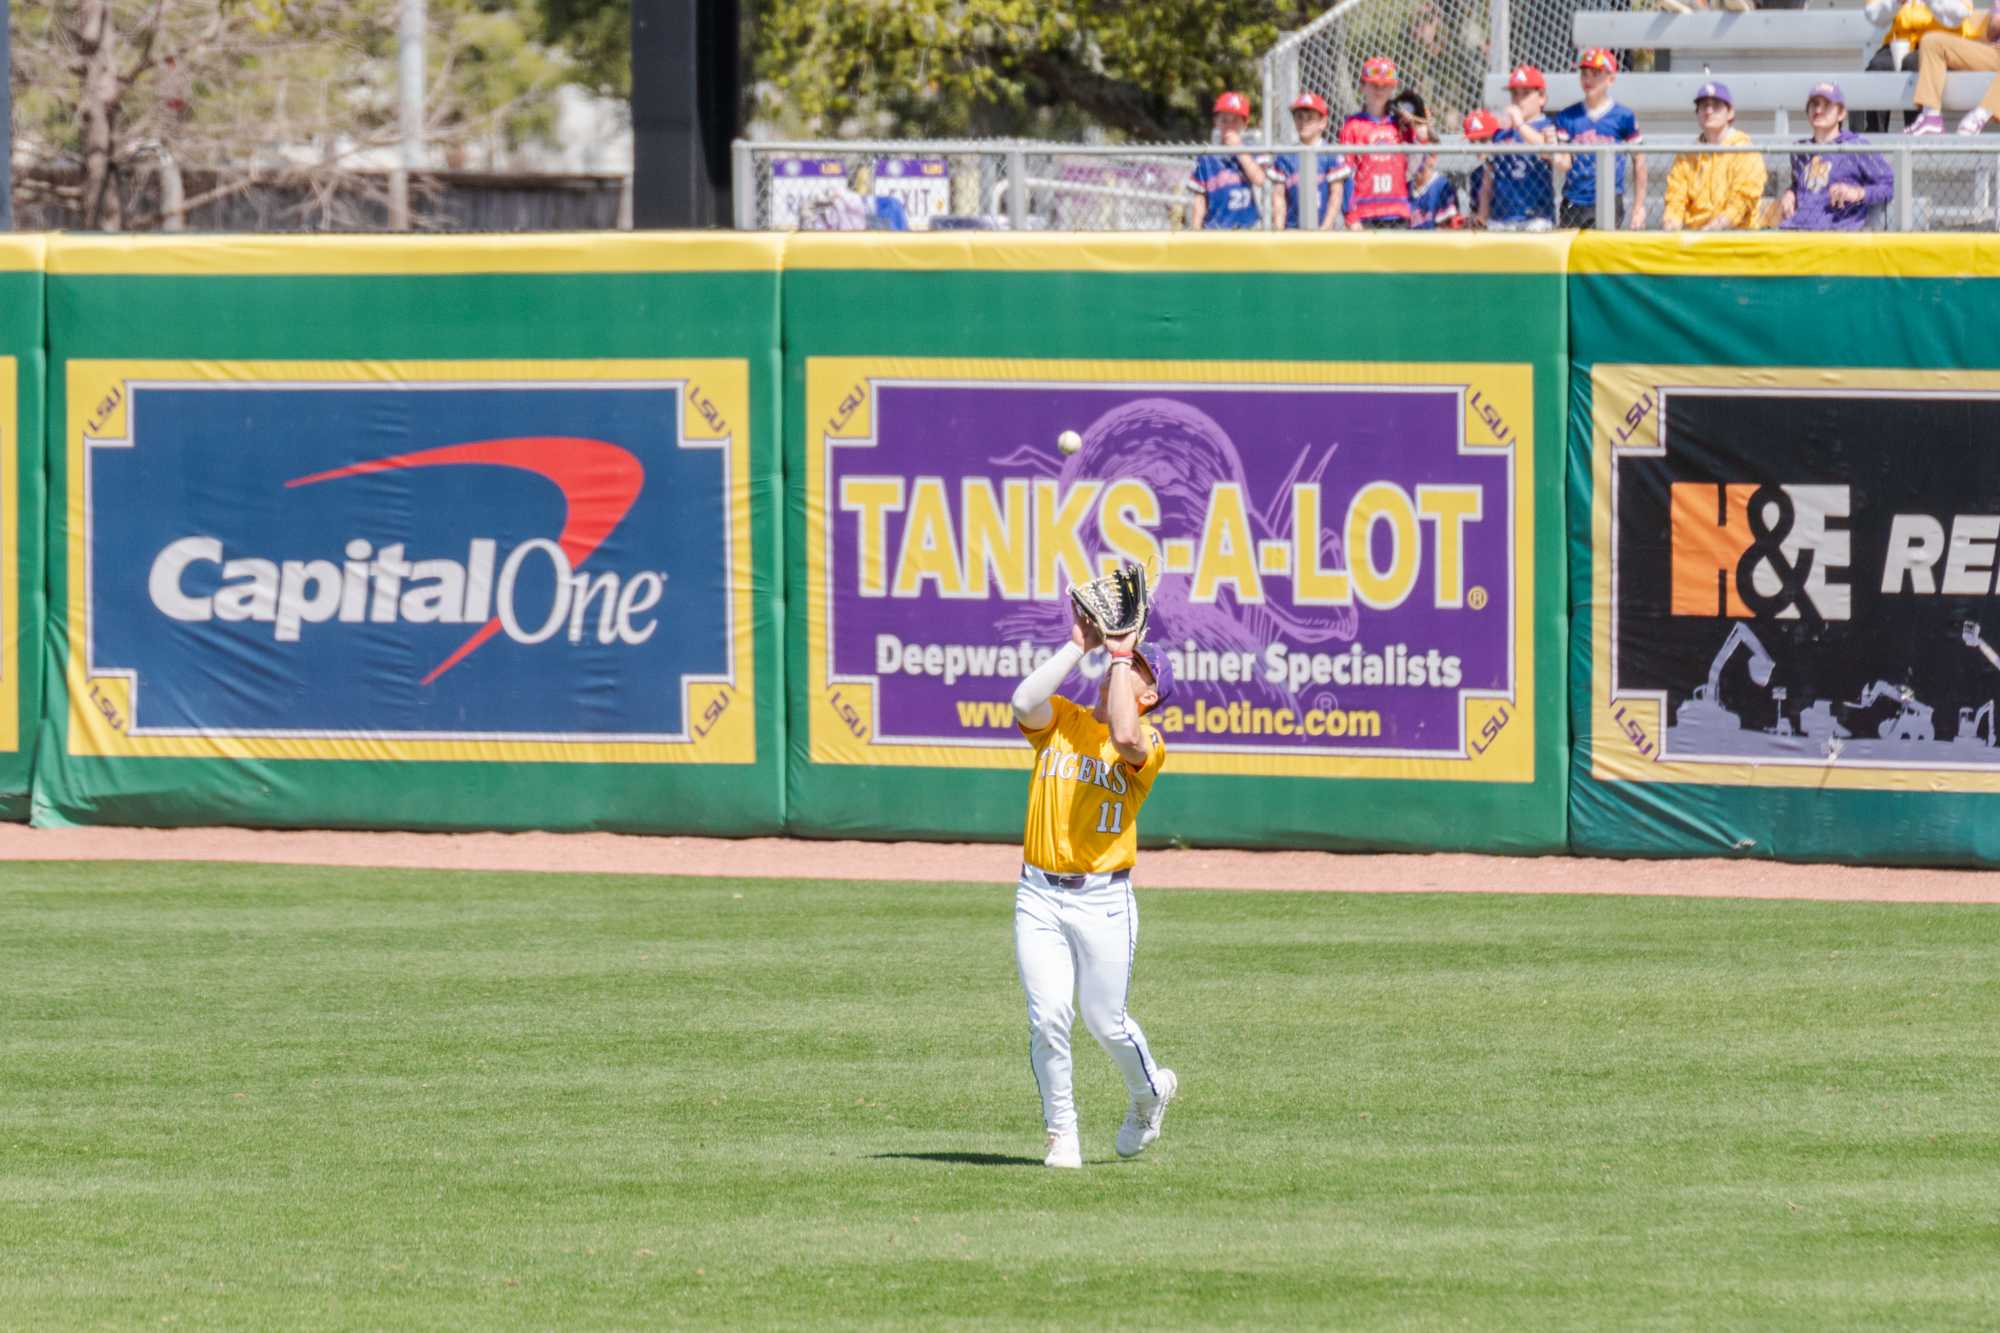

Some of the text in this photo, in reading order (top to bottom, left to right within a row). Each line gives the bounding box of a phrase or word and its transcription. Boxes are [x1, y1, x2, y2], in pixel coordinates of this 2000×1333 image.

[87, 385, 121, 432] LSU
[689, 385, 727, 433] LSU
[829, 385, 866, 432] LSU
[1470, 391, 1510, 440] LSU
[1615, 393, 1653, 442] LSU
[1670, 481, 2000, 620] H&E RE
[876, 633, 1057, 685] Deepwate
[1264, 641, 1463, 693] Specialists
[89, 686, 123, 731] LSU
[694, 690, 730, 738] LSU
[831, 691, 868, 739] LSU
[1472, 705, 1510, 755] LSU
[1615, 706, 1653, 756] LSU
[1038, 746, 1129, 796] TIGERS
[1095, 800, 1124, 835] 11
